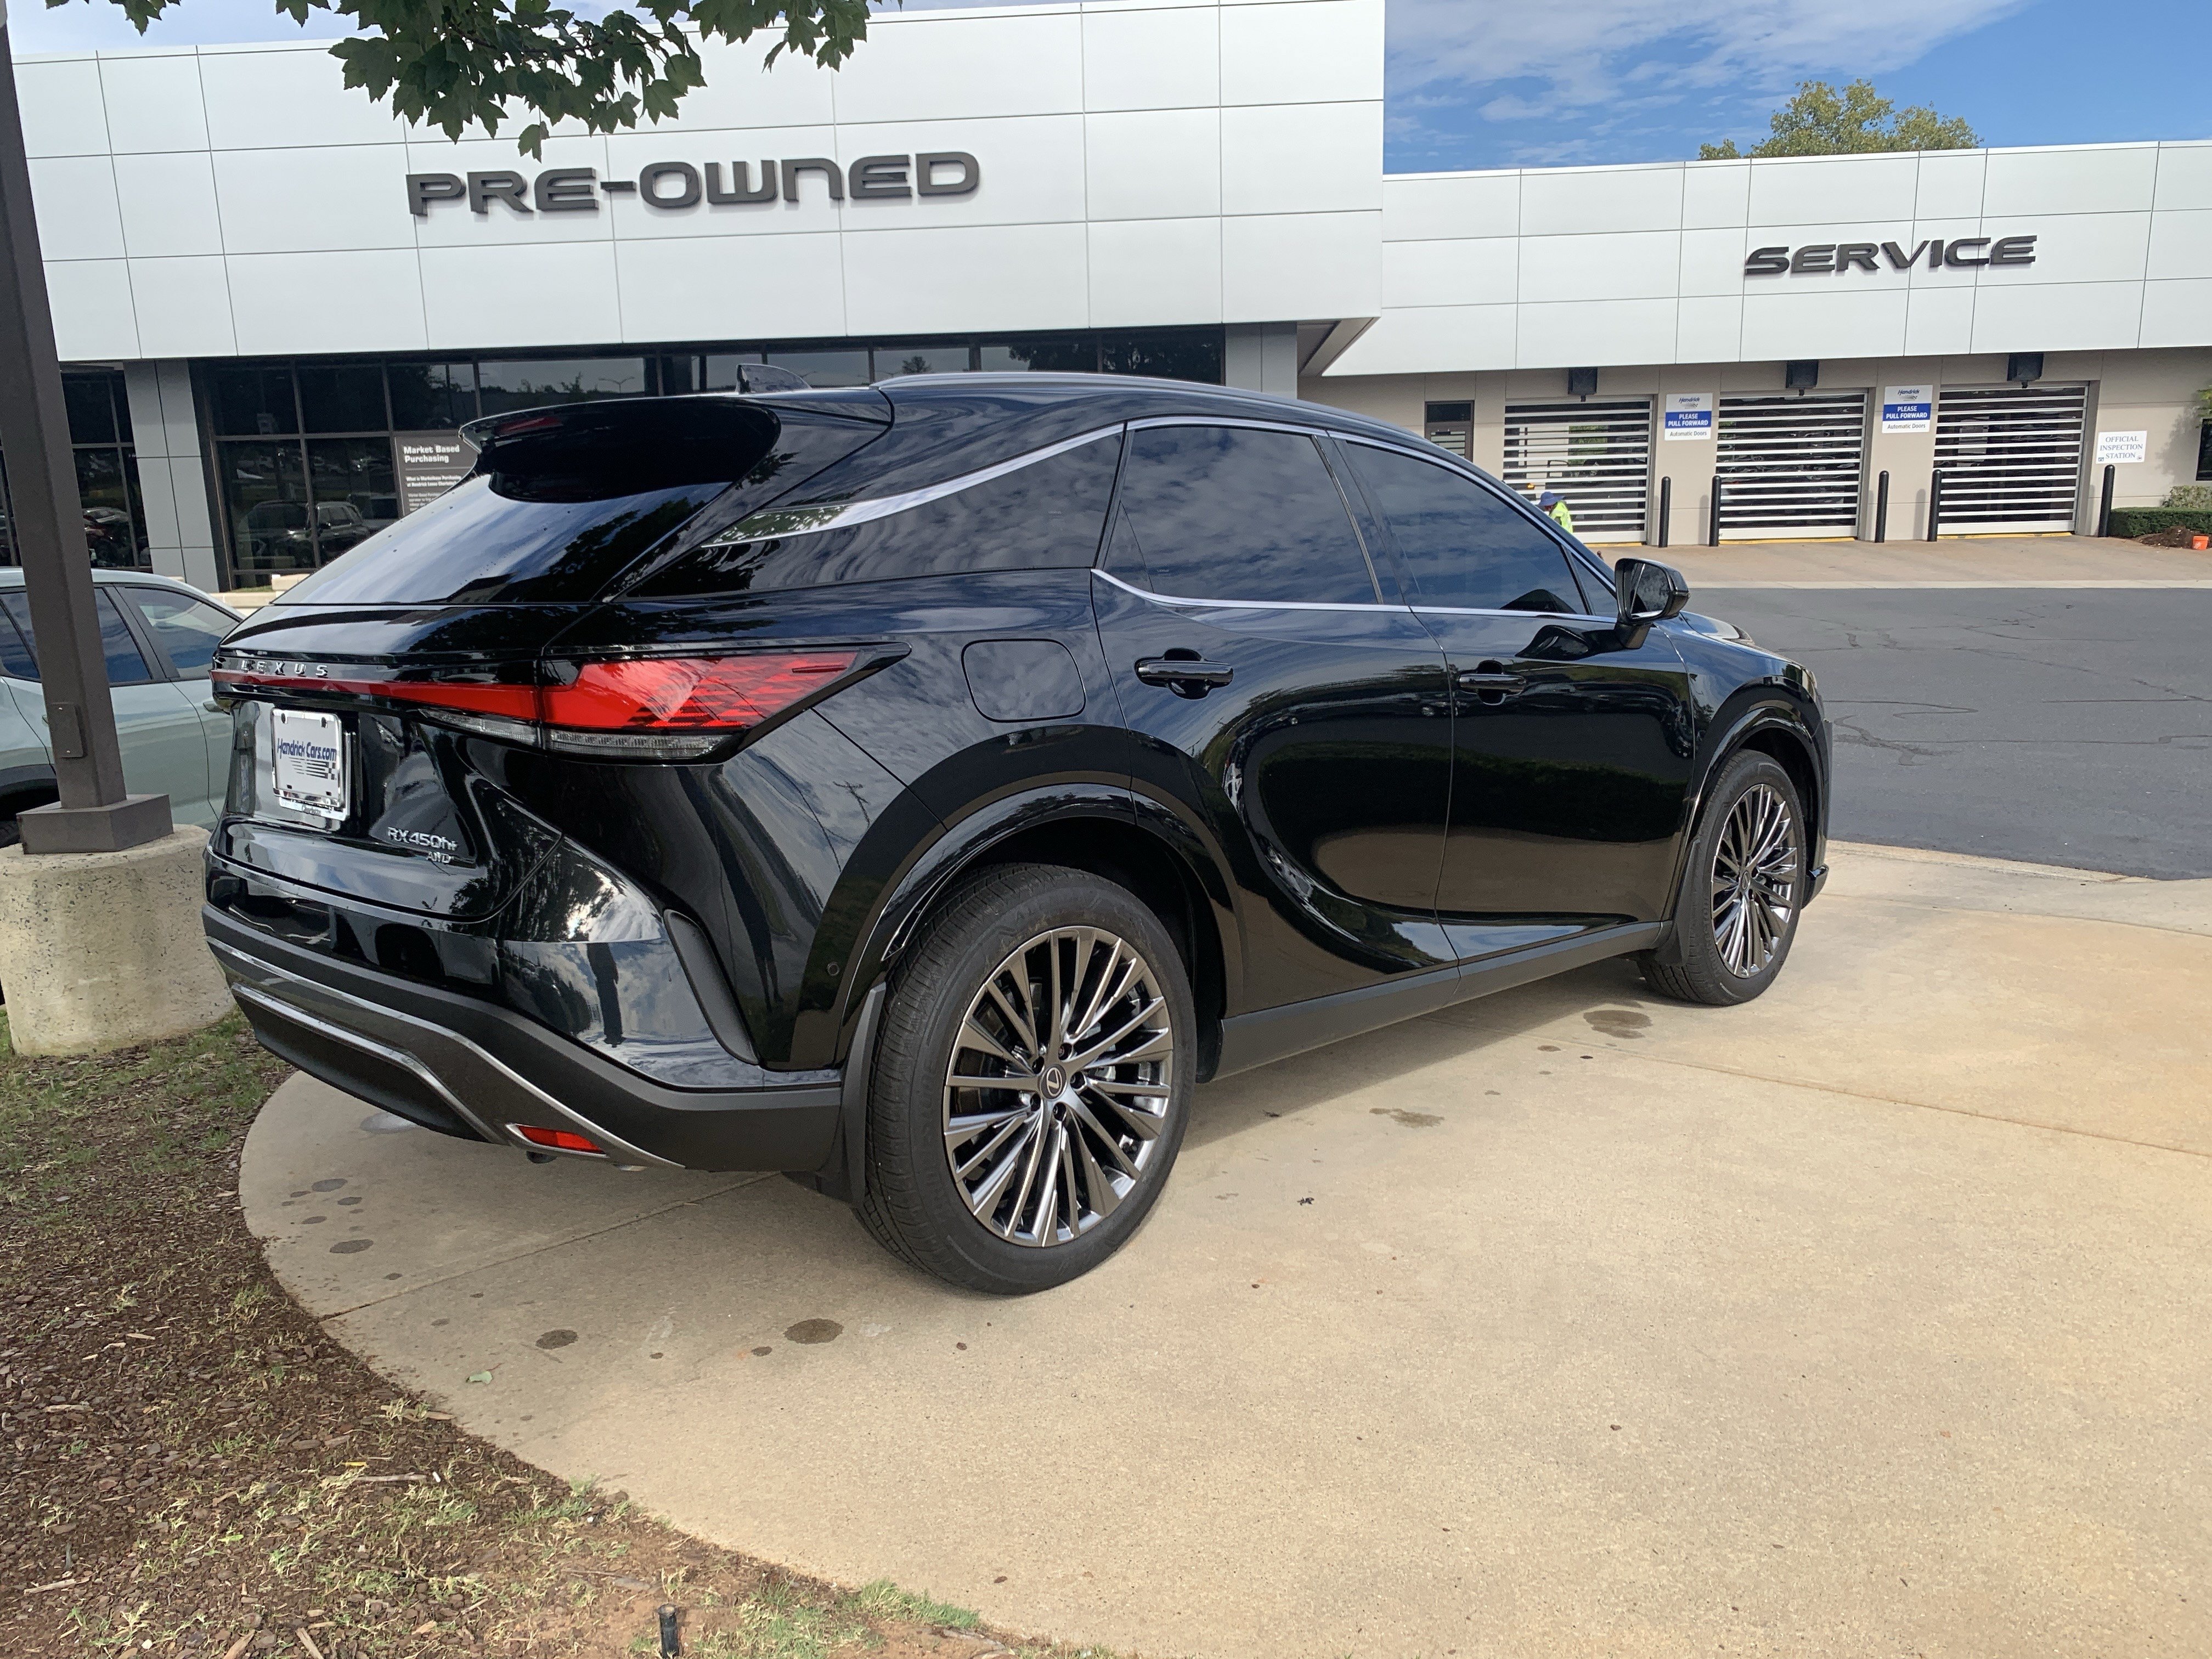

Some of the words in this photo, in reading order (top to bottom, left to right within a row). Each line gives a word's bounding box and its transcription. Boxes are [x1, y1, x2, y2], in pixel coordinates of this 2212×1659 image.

[405, 151, 979, 216] PRE-OWNED
[1745, 235, 2038, 275] SERVICE
[403, 445, 433, 454] Market
[436, 444, 460, 453] Based
[404, 454, 449, 463] Purchasing
[241, 660, 329, 678] LEXUS
